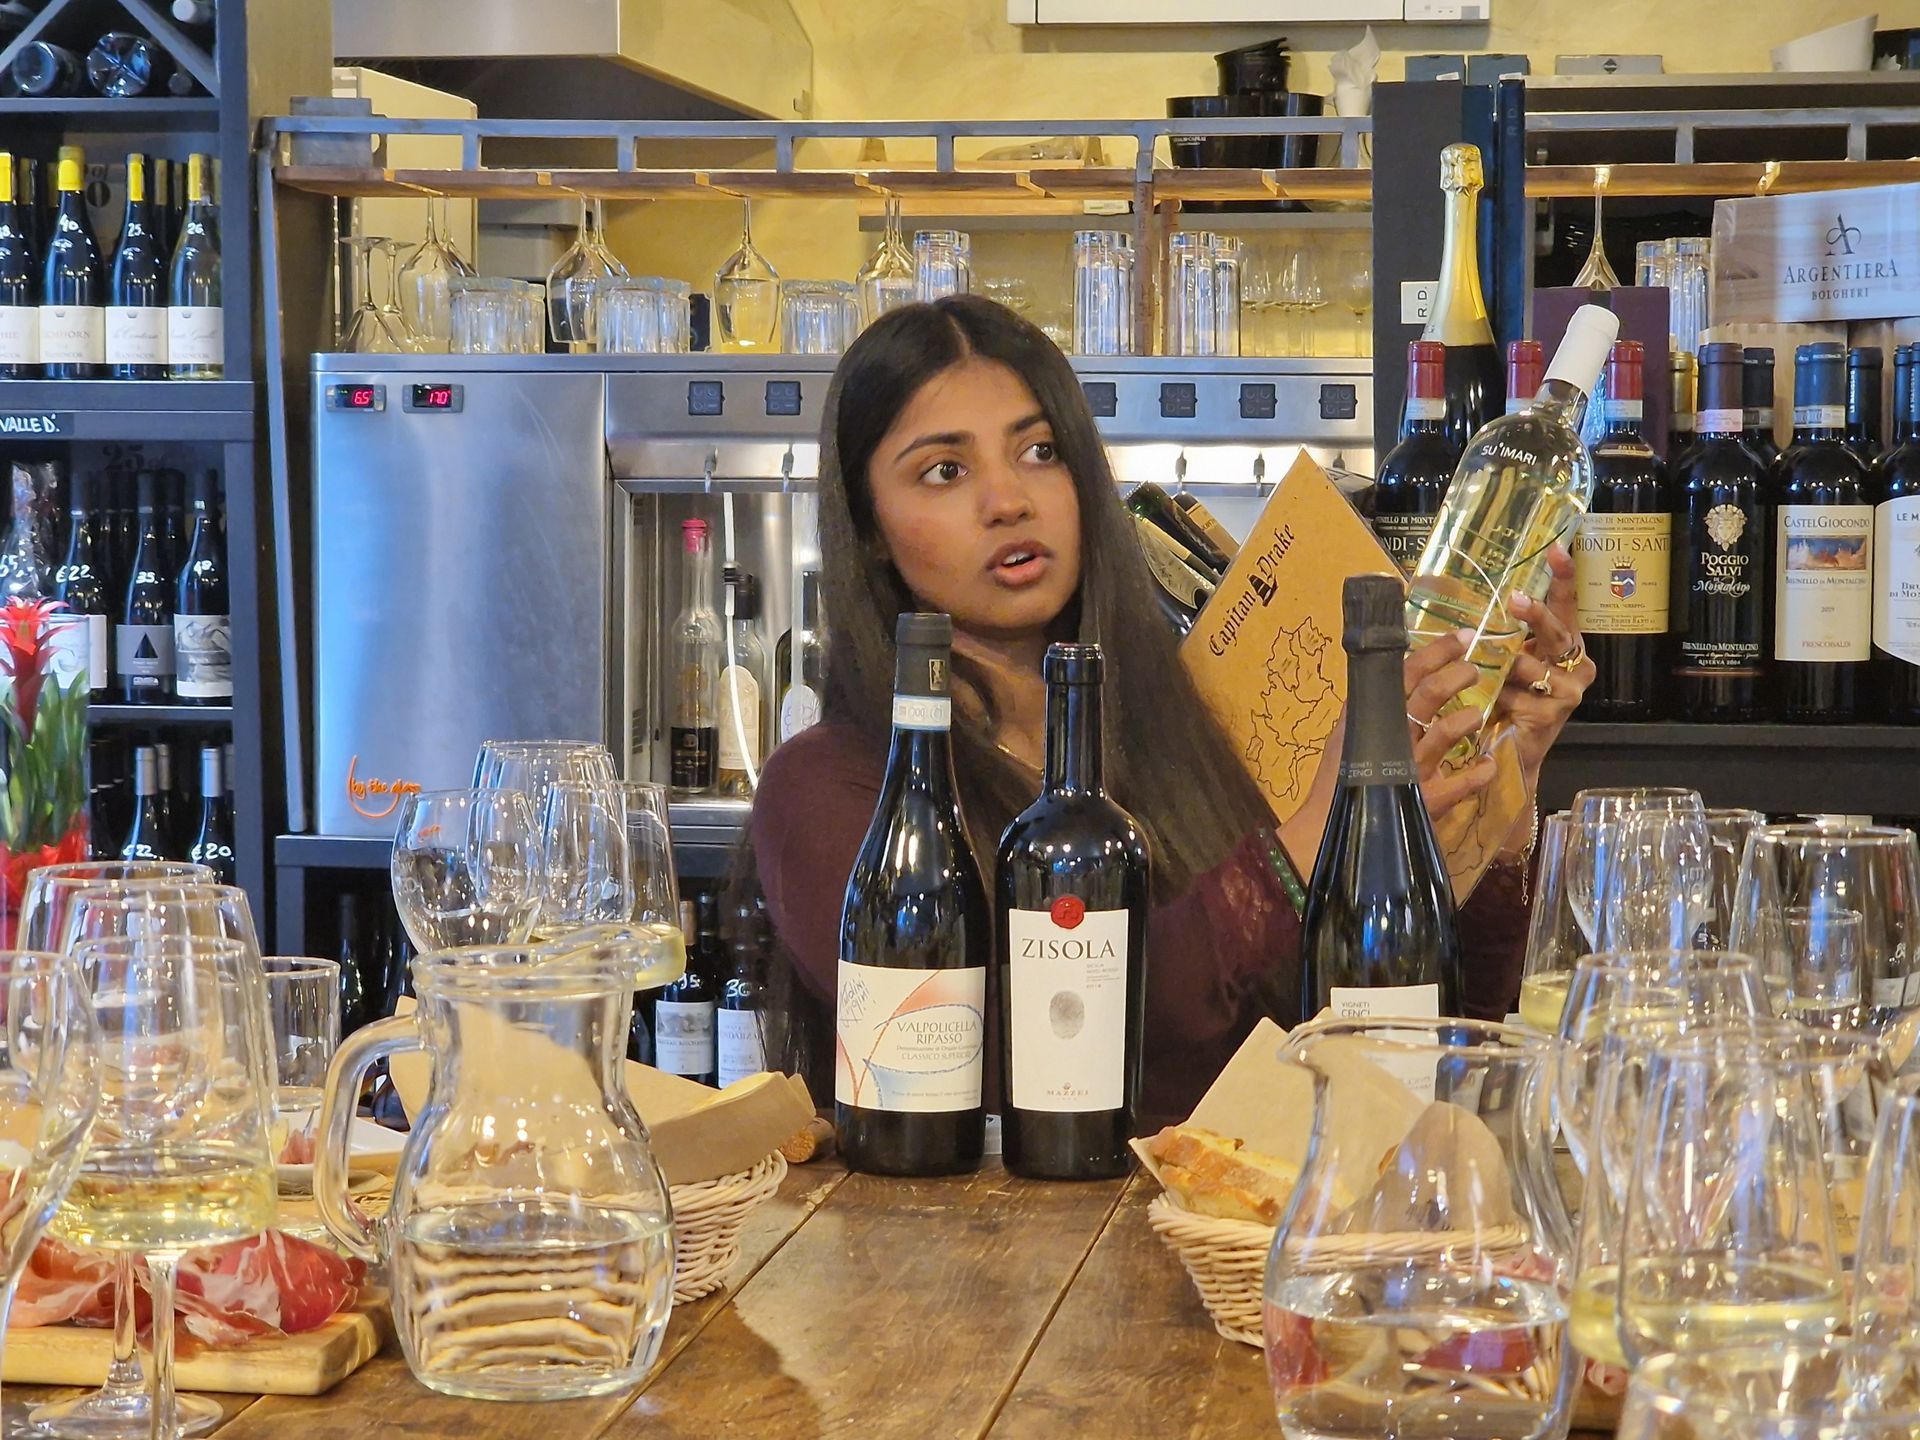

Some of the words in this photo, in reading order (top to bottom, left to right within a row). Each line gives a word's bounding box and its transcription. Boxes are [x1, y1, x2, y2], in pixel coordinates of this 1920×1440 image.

[1783, 258, 1899, 285] ARGENTIERA
[1811, 287, 1869, 301] BOLGHERI
[1411, 516, 1434, 524] MONT
[1896, 512, 1908, 521] LE
[1911, 512, 1920, 521] M
[1701, 552, 1749, 565] POGGIO
[1706, 563, 1742, 577] SALVI
[1209, 590, 1257, 656] Capitan
[1256, 524, 1295, 580] Drake
[1022, 938, 1116, 960] ZISOLA
[1341, 1001, 1370, 1009] VIGNETI
[1341, 1009, 1370, 1017] CENCI
[896, 1020, 977, 1033] VALPOLICELLA
[916, 1033, 963, 1045] RIPASSO
